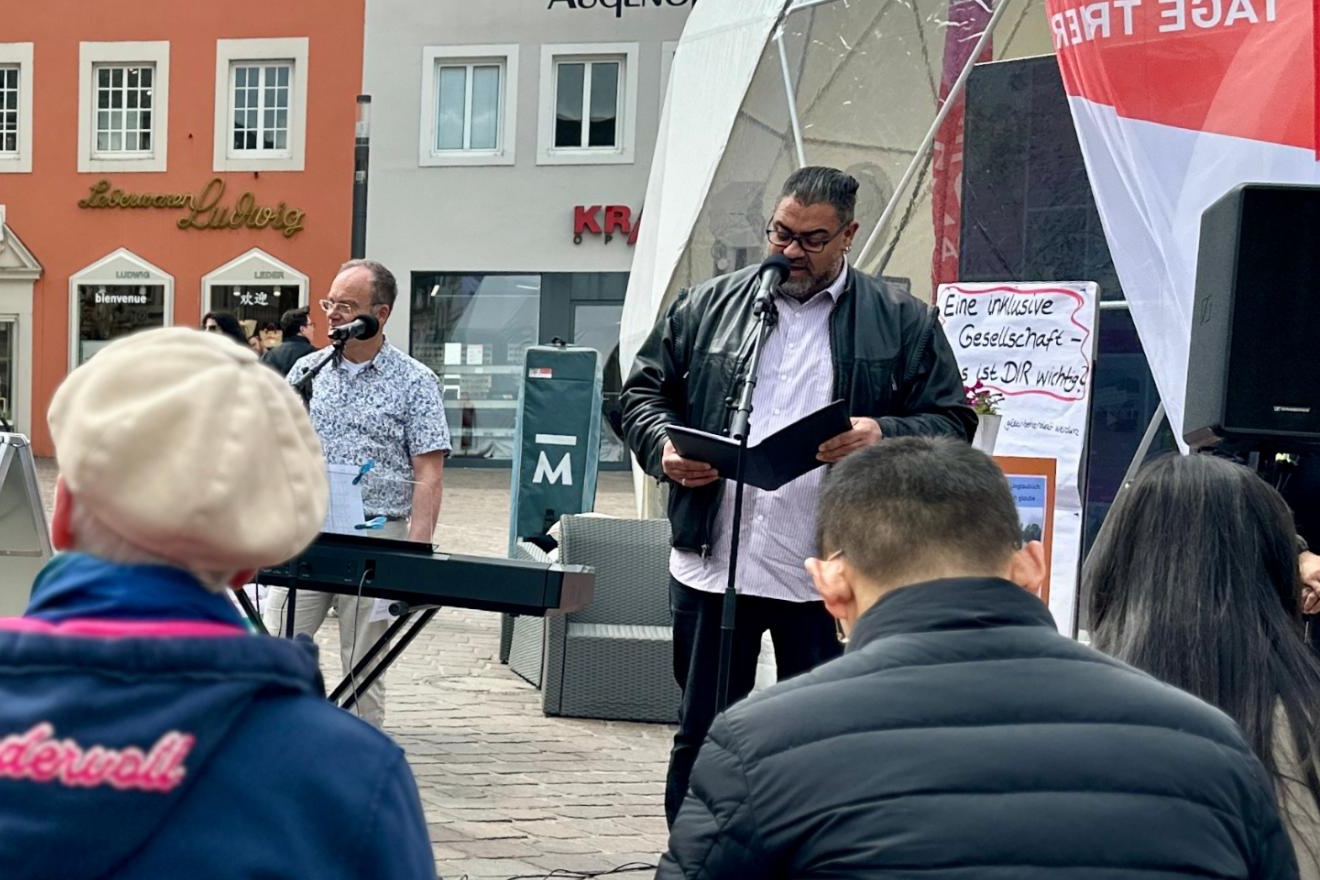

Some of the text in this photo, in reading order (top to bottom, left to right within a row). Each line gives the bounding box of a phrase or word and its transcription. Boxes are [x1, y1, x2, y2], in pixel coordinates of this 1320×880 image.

[178, 178, 305, 238] Ludwig
[116, 271, 150, 280] LUDWIG
[254, 271, 284, 280] LEDER
[95, 293, 147, 305] bienvenue
[240, 292, 269, 306] 欢迎
[944, 294, 1054, 317] Eine inklusive
[959, 323, 1064, 352] Gesellschaft
[1000, 360, 1033, 386] DIR
[1036, 365, 1090, 394] wichtig?
